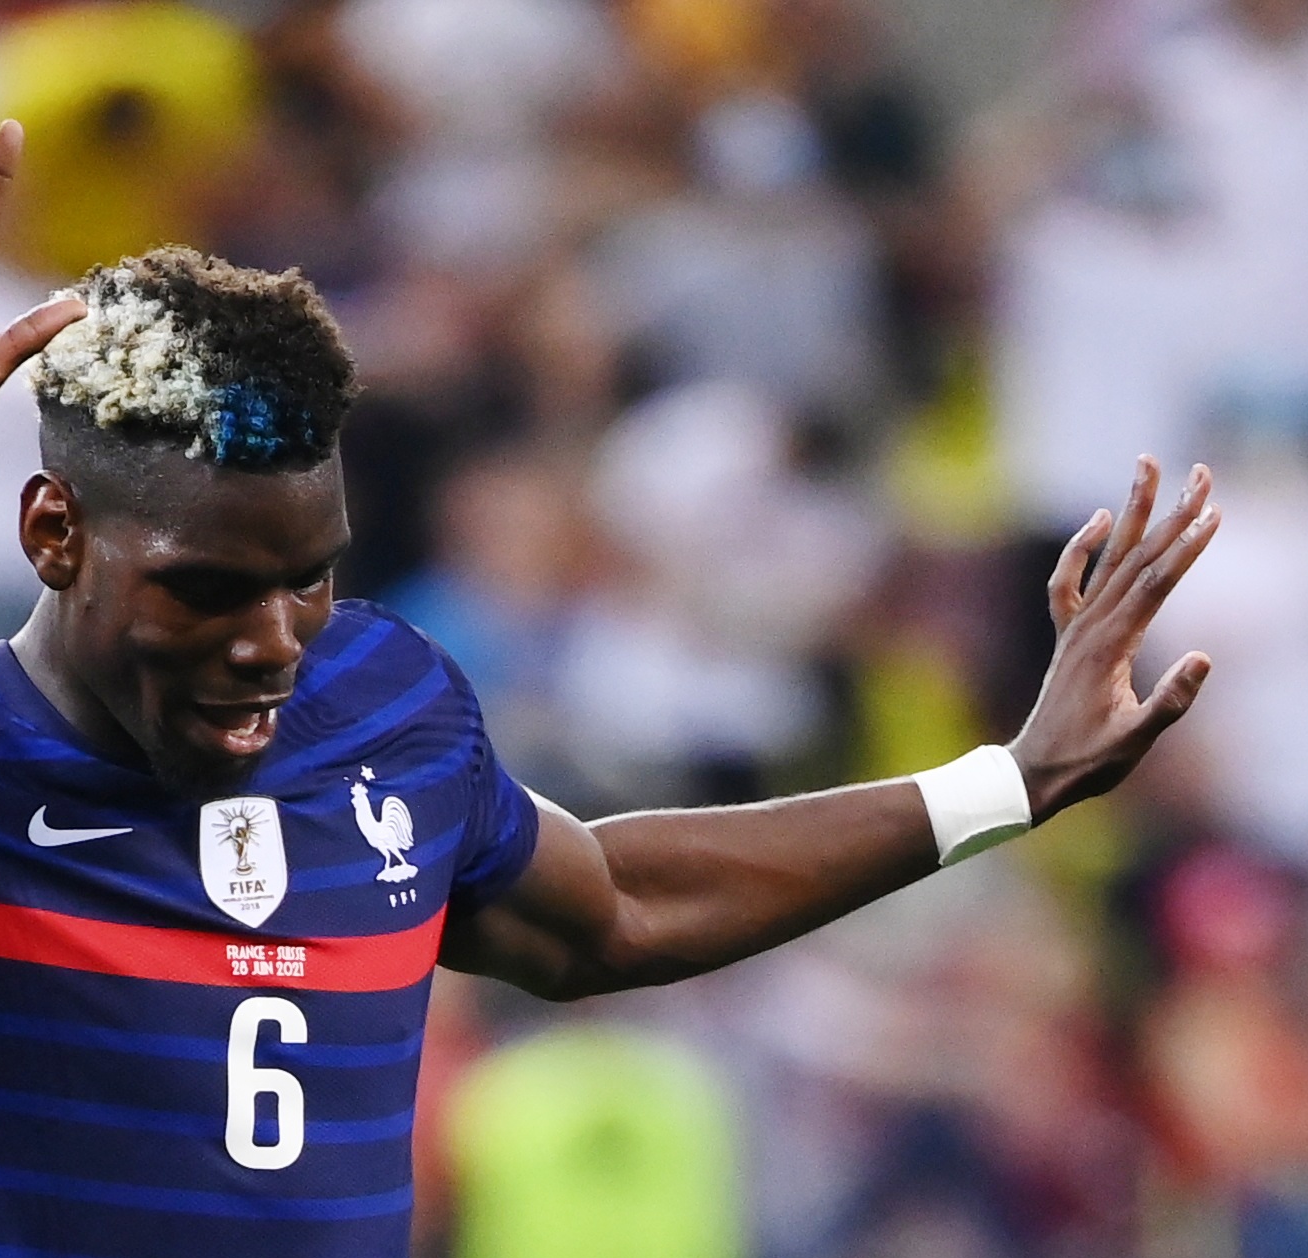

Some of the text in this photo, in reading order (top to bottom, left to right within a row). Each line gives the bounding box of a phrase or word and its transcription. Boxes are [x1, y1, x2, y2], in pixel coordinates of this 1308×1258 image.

[229, 880, 264, 895] FIFA
[226, 944, 266, 961] FRANCE
[276, 945, 307, 962] SUISSE
[231, 960, 305, 977] 28 JUIN 2021
[224, 996, 308, 1170] 6
